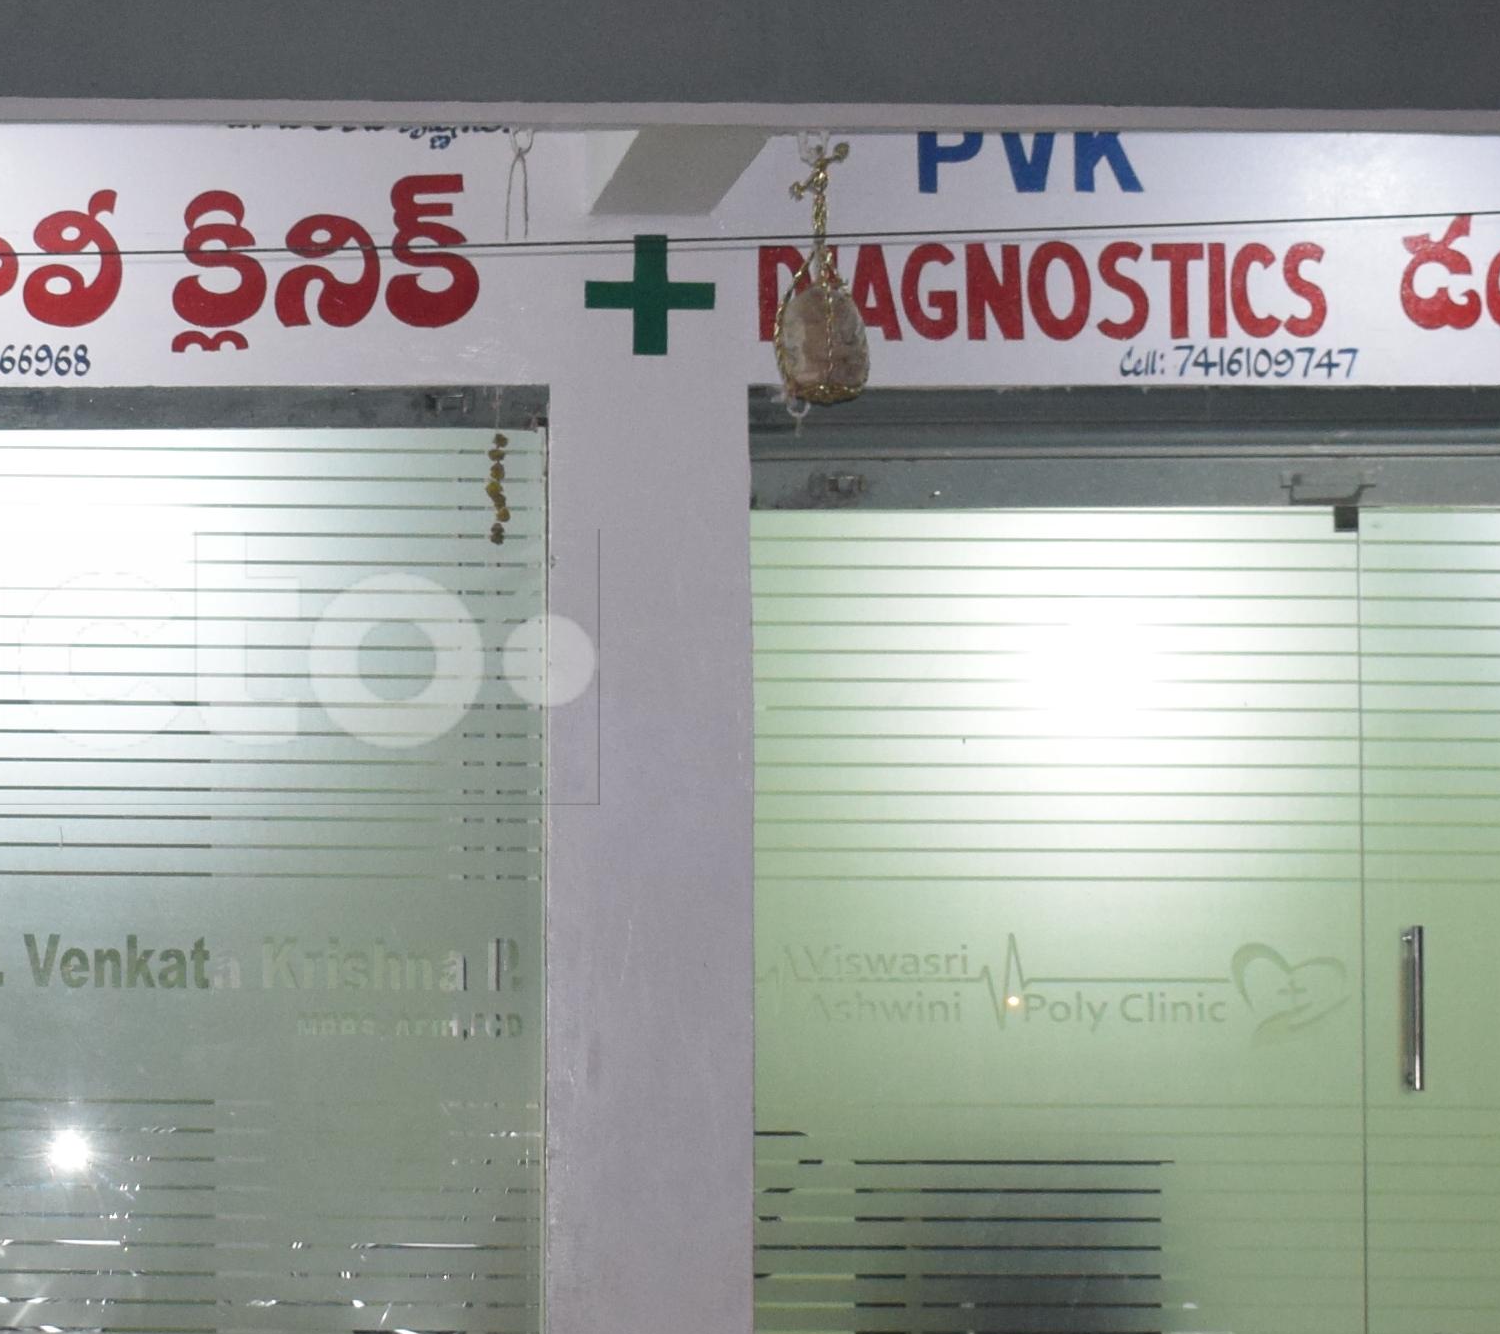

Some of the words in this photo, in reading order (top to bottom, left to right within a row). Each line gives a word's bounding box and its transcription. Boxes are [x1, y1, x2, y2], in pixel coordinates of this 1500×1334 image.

[918, 132, 1145, 194] PVK
[1120, 346, 1165, 377] Cell:
[1173, 345, 1359, 378] 7416109747
[22, 932, 242, 990] Venkata
[260, 935, 466, 992] Krishna
[801, 945, 969, 977] Viswasri
[806, 991, 961, 1024] Ashwini
[1023, 993, 1111, 1031] Poly
[1120, 991, 1227, 1024] Clinic
